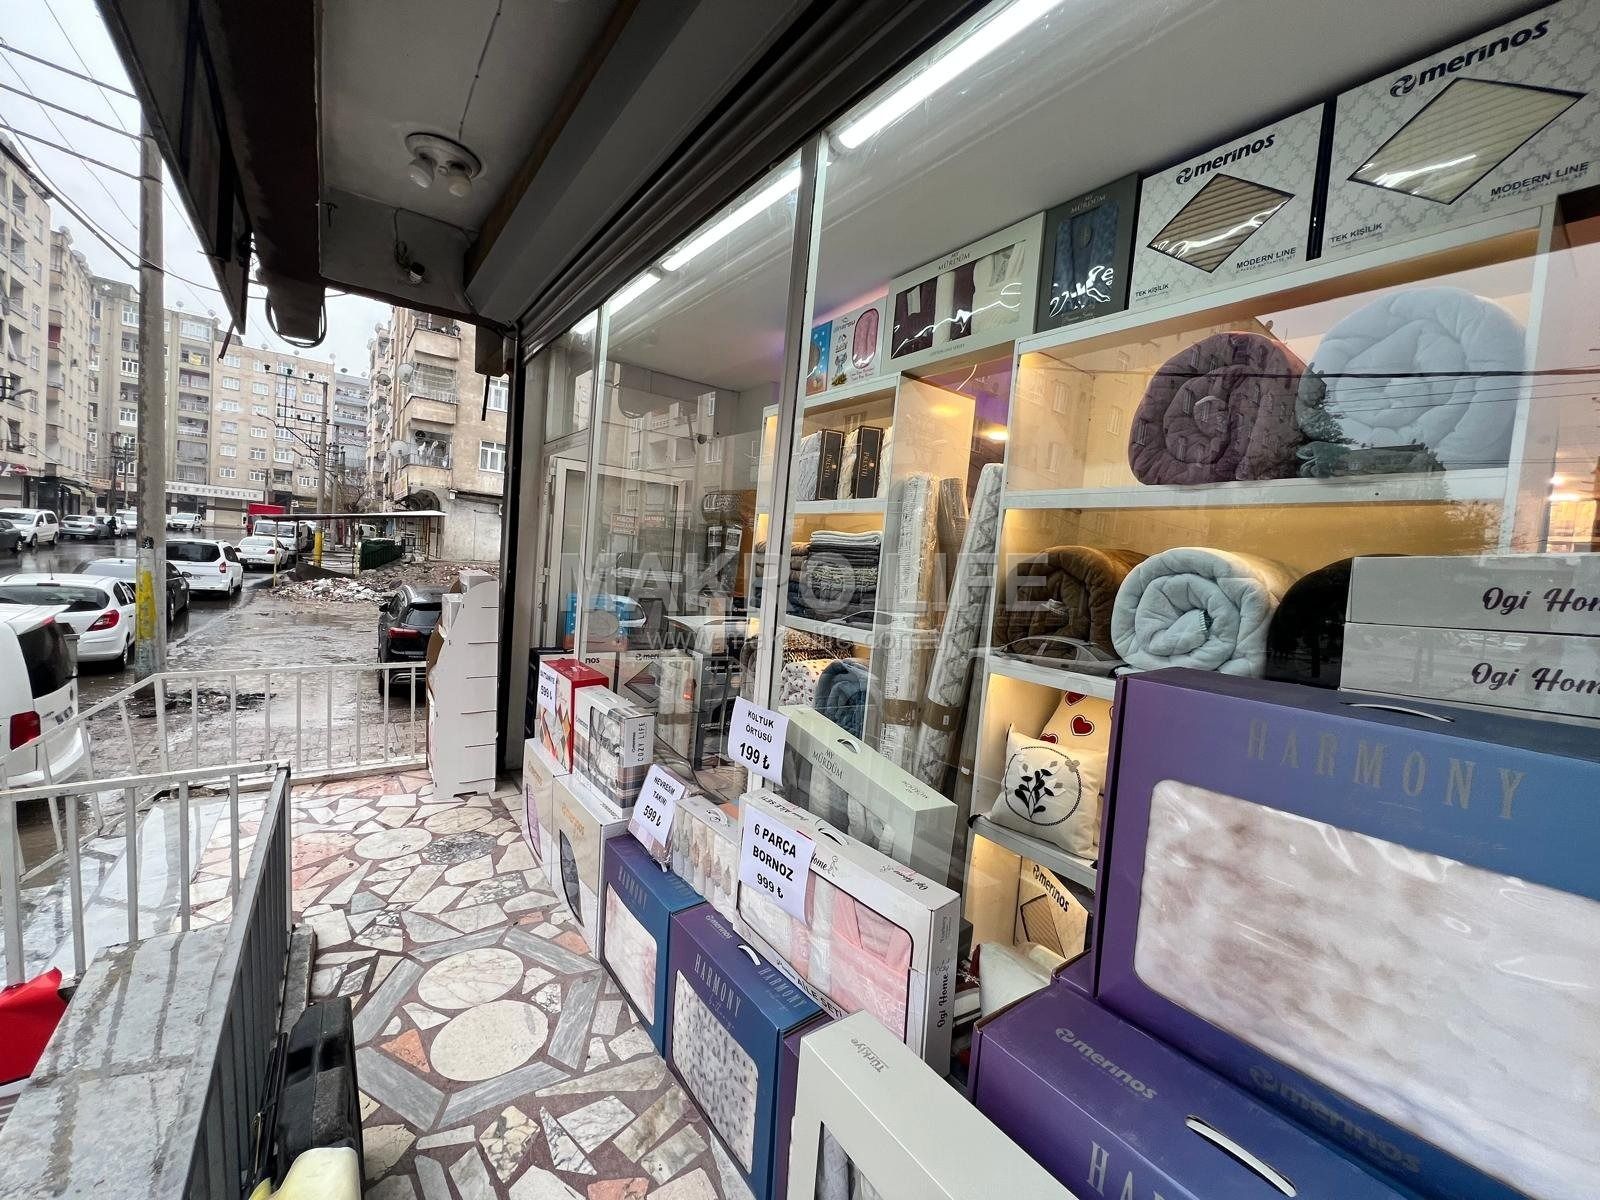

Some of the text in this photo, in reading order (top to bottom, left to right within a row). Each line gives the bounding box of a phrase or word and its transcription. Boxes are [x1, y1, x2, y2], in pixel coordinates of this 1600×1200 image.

[1418, 19, 1550, 85] merinos
[1193, 134, 1276, 177] merinos
[1491, 161, 1590, 196] MODERN LINE
[1331, 231, 1349, 243] TEK
[1236, 247, 1297, 269] MODERN LINE
[1482, 587, 1532, 615] Ogi
[1471, 662, 1520, 691] Ogi
[638, 722, 646, 739] LIFE
[747, 710, 775, 728] KOLTUK
[740, 742, 760, 764] 199
[812, 751, 844, 780] MÜRDÜM
[825, 749, 834, 758] MY
[1247, 717, 1527, 820] HARMONY
[643, 804, 657, 822] 599
[754, 823, 796, 858] 6 PARÇA
[753, 845, 794, 882] BORNOZ
[757, 873, 775, 893] 999
[1038, 872, 1070, 912] merinos
[694, 953, 741, 1017] HARMONY
[758, 967, 807, 1008] HARMONY
[937, 974, 949, 1028] Ogi Home
[1072, 1039, 1157, 1099] merinos
[1087, 1140, 1166, 1200] HA
